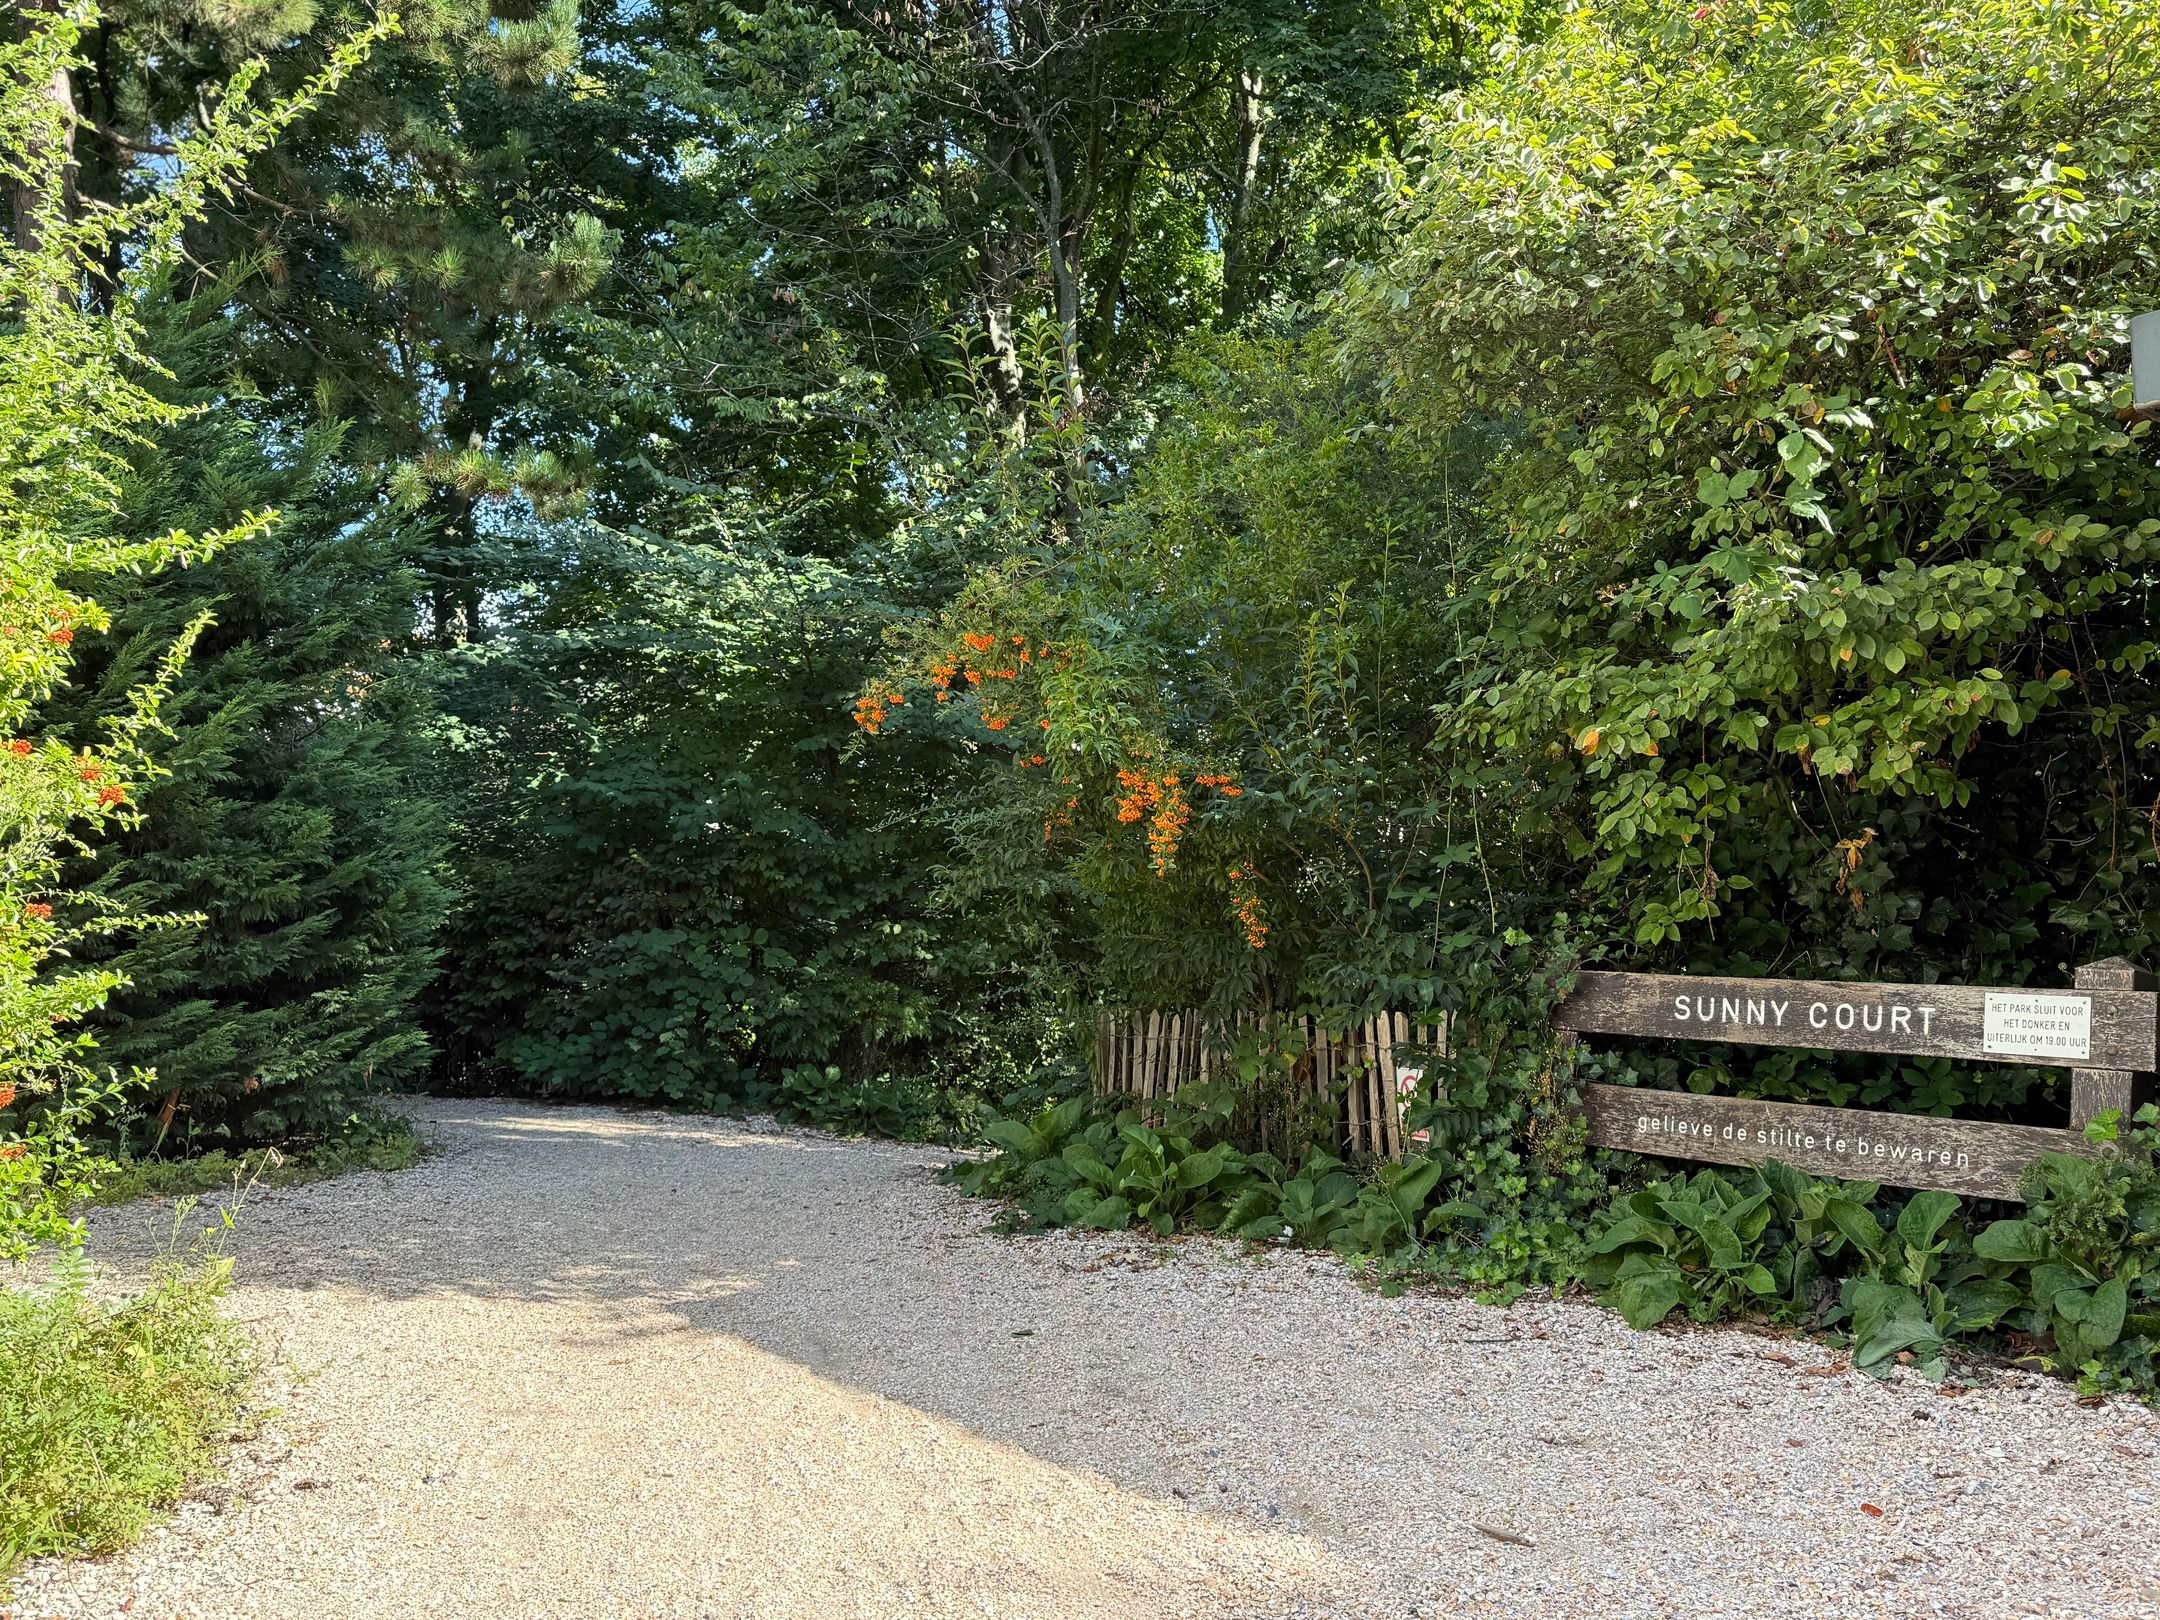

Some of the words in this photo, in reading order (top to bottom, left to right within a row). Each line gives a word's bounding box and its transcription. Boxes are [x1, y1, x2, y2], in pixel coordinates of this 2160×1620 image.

[1673, 995, 1789, 1027] SUNNY
[1808, 1001, 1937, 1036] COURT
[1991, 1003, 2007, 1013] HET
[2009, 1003, 2032, 1014] PARK
[2034, 1004, 2057, 1015] SLUIT
[2059, 1006, 2084, 1016] VOOR
[2003, 1018, 2019, 1028] HET
[2021, 1019, 2056, 1030] DONKER
[2058, 1021, 2070, 1031] EN
[1987, 1033, 2028, 1044] UITERLIJK
[2029, 1035, 2043, 1045] OM
[2045, 1036, 2067, 1046] 19.00
[2069, 1037, 2087, 1048] UUR
[1637, 1115, 1714, 1138] gelieve
[1722, 1122, 1748, 1141] de
[1756, 1127, 1815, 1149] stilte
[1825, 1134, 1848, 1152] te
[1857, 1137, 1970, 1168] bewaren
